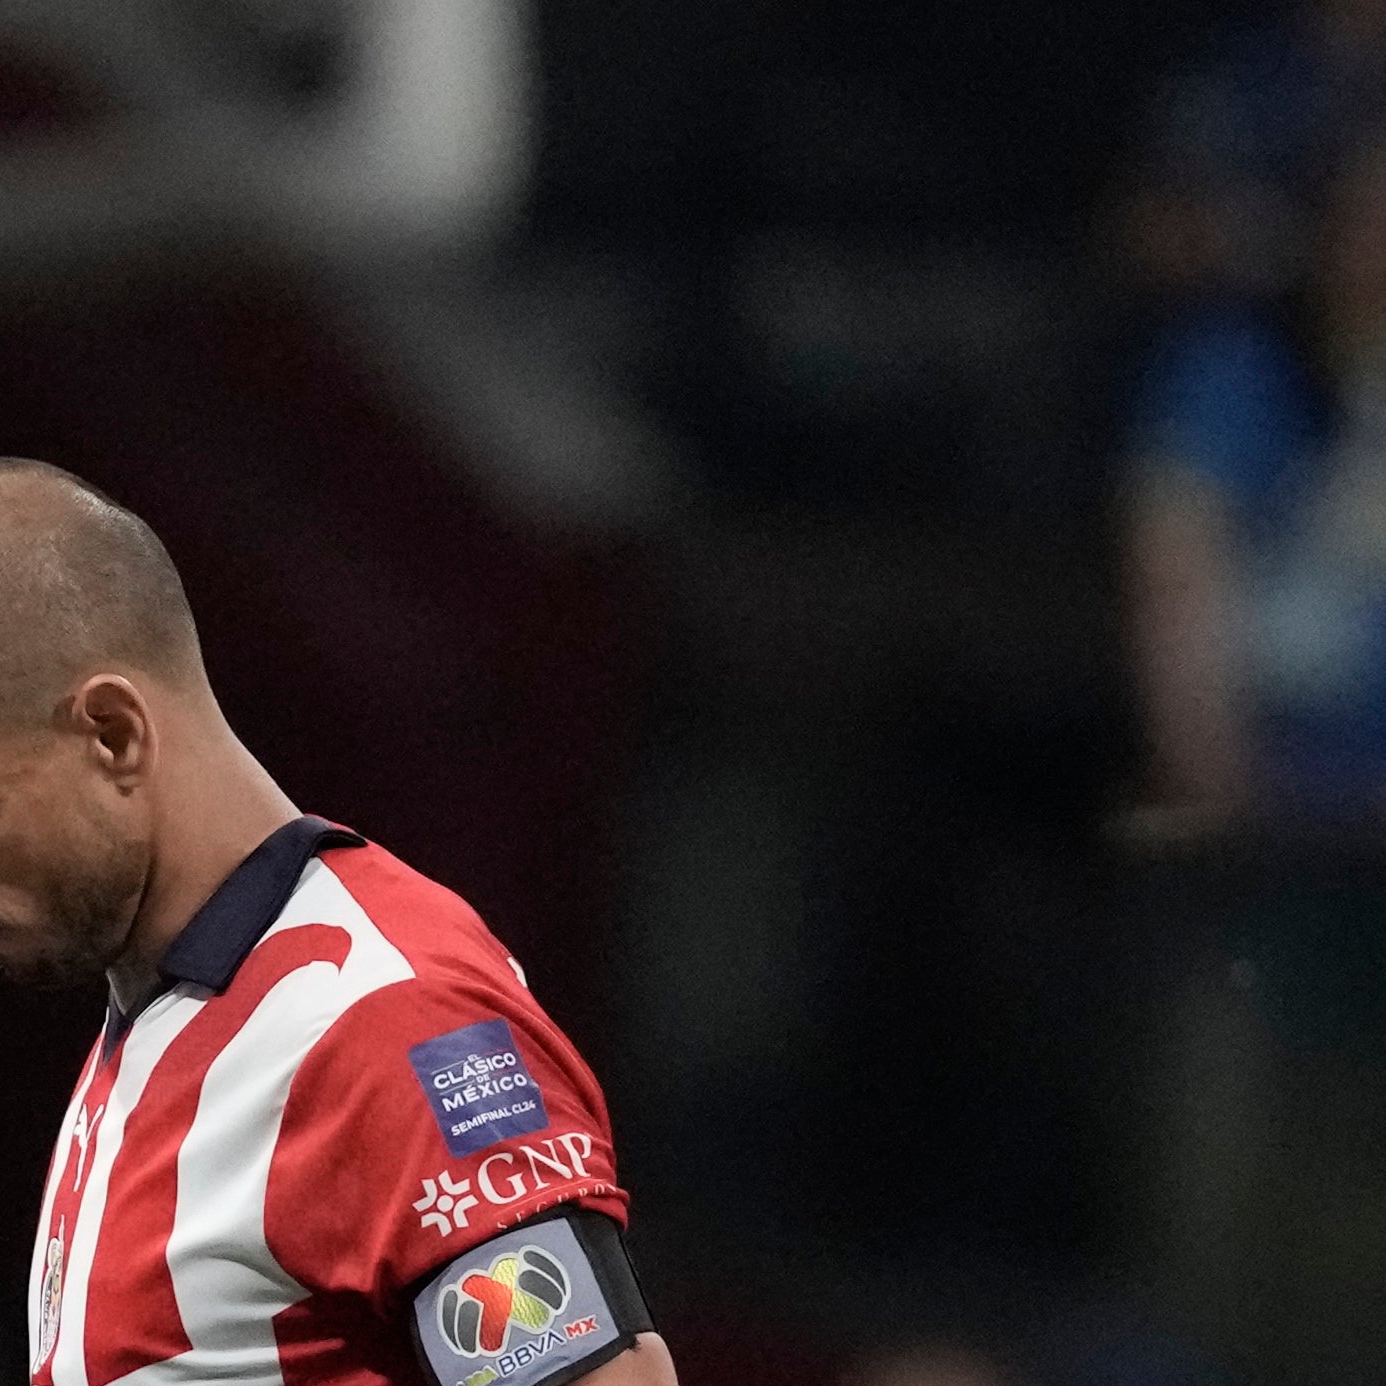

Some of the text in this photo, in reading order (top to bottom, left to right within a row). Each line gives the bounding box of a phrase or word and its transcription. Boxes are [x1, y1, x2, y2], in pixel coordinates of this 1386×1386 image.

[442, 1073, 527, 1112] MÉXICO
[451, 1107, 512, 1136] SEMIFINAL
[477, 1132, 592, 1205] GNP
[498, 1317, 599, 1375] BBVA MX
